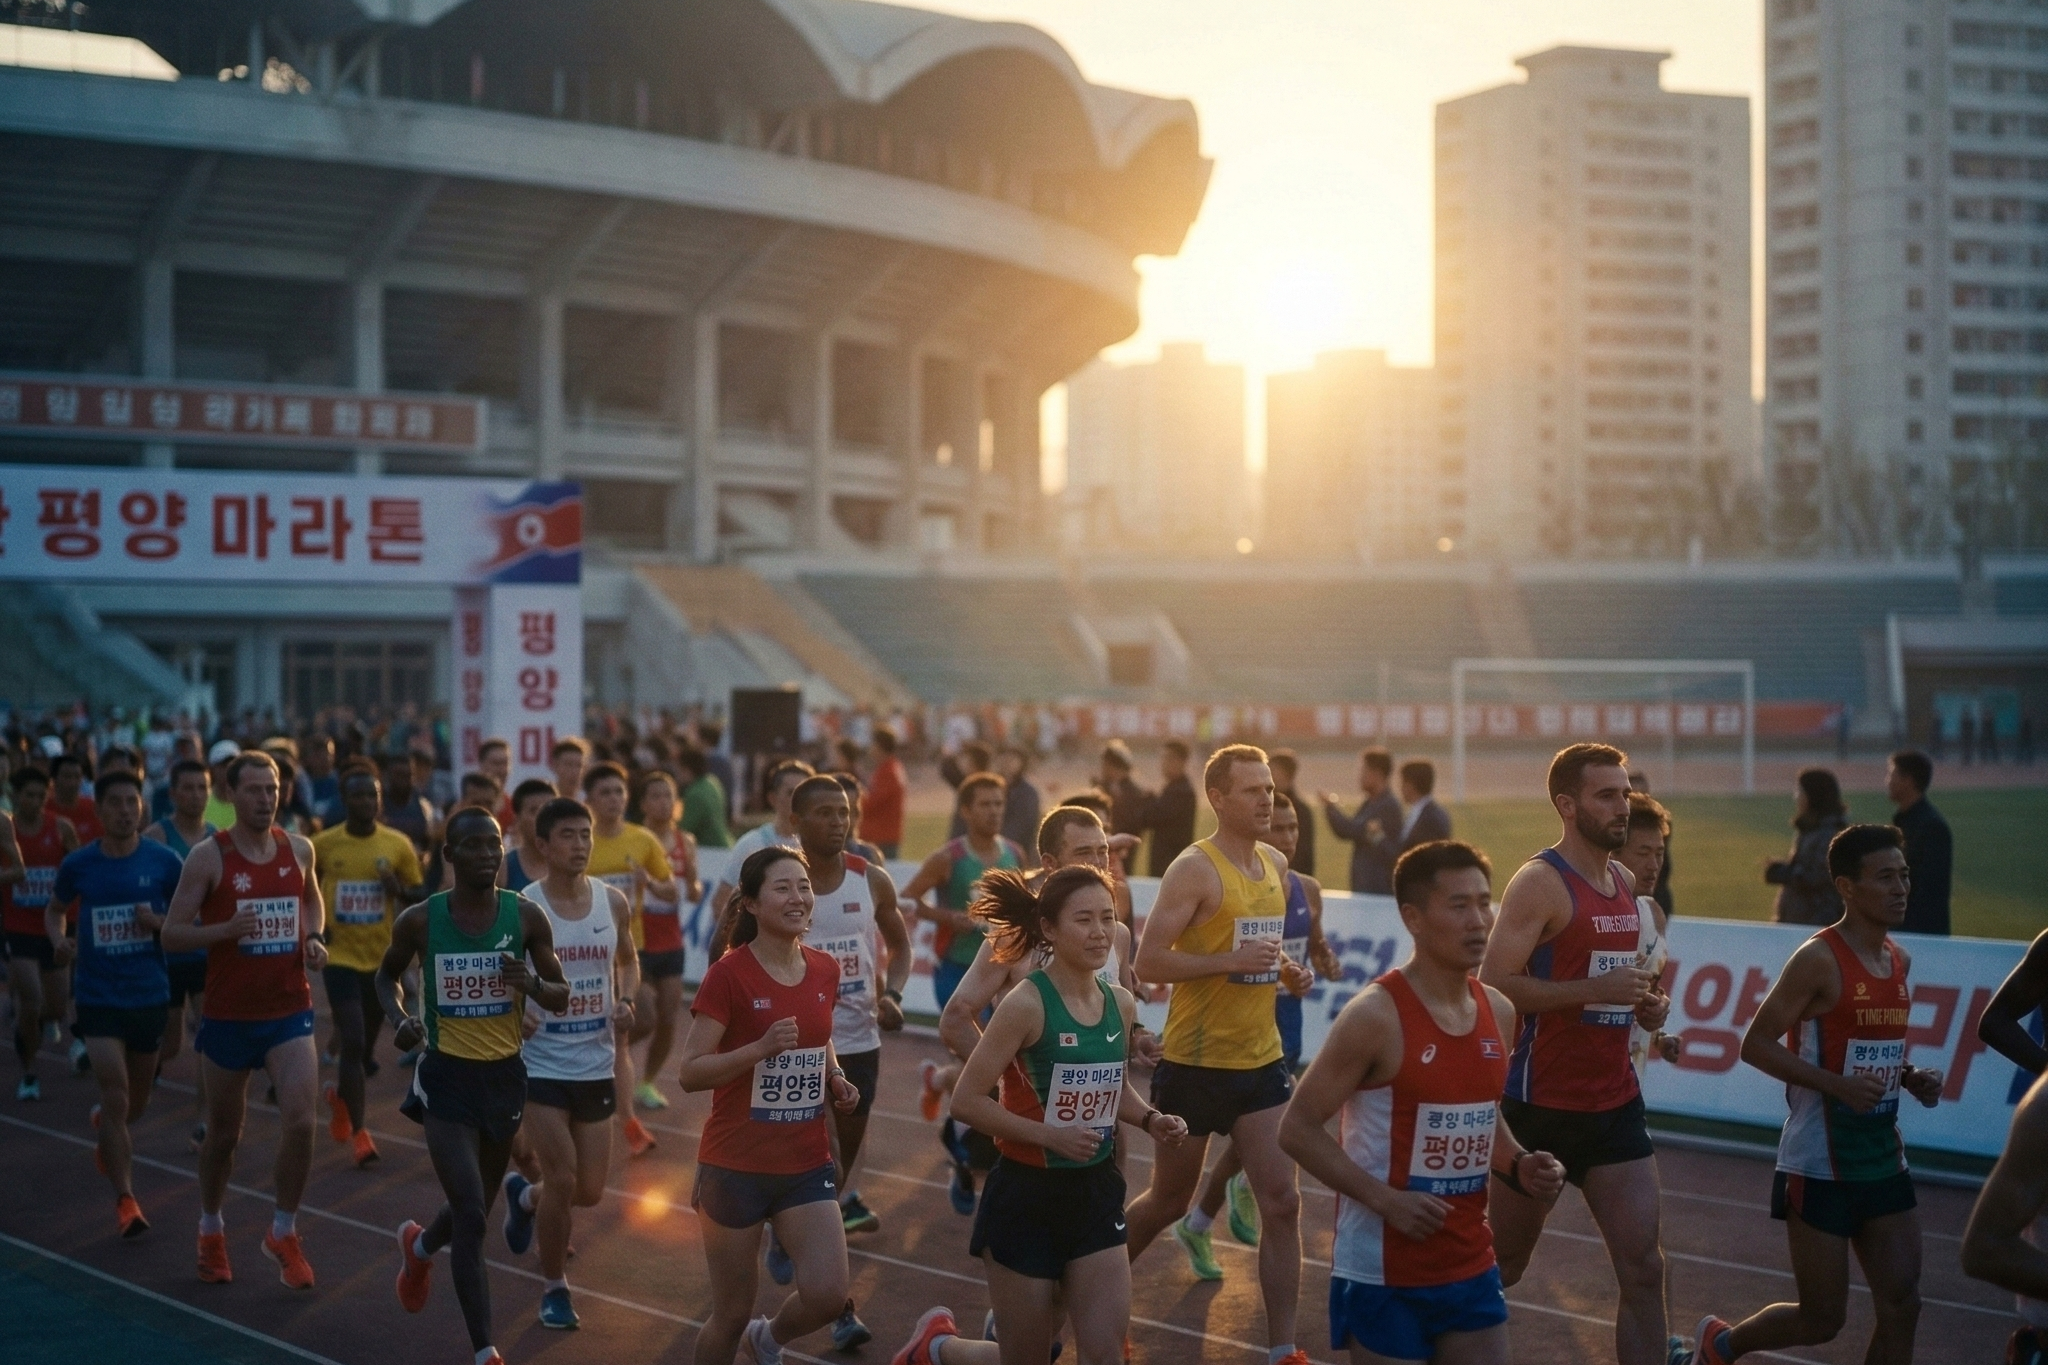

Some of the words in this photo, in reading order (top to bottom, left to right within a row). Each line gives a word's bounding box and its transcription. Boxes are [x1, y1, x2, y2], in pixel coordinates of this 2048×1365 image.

[38, 488, 187, 561] 평양
[212, 490, 427, 564] 마라톤
[1054, 1089, 1118, 1122] 평양기
